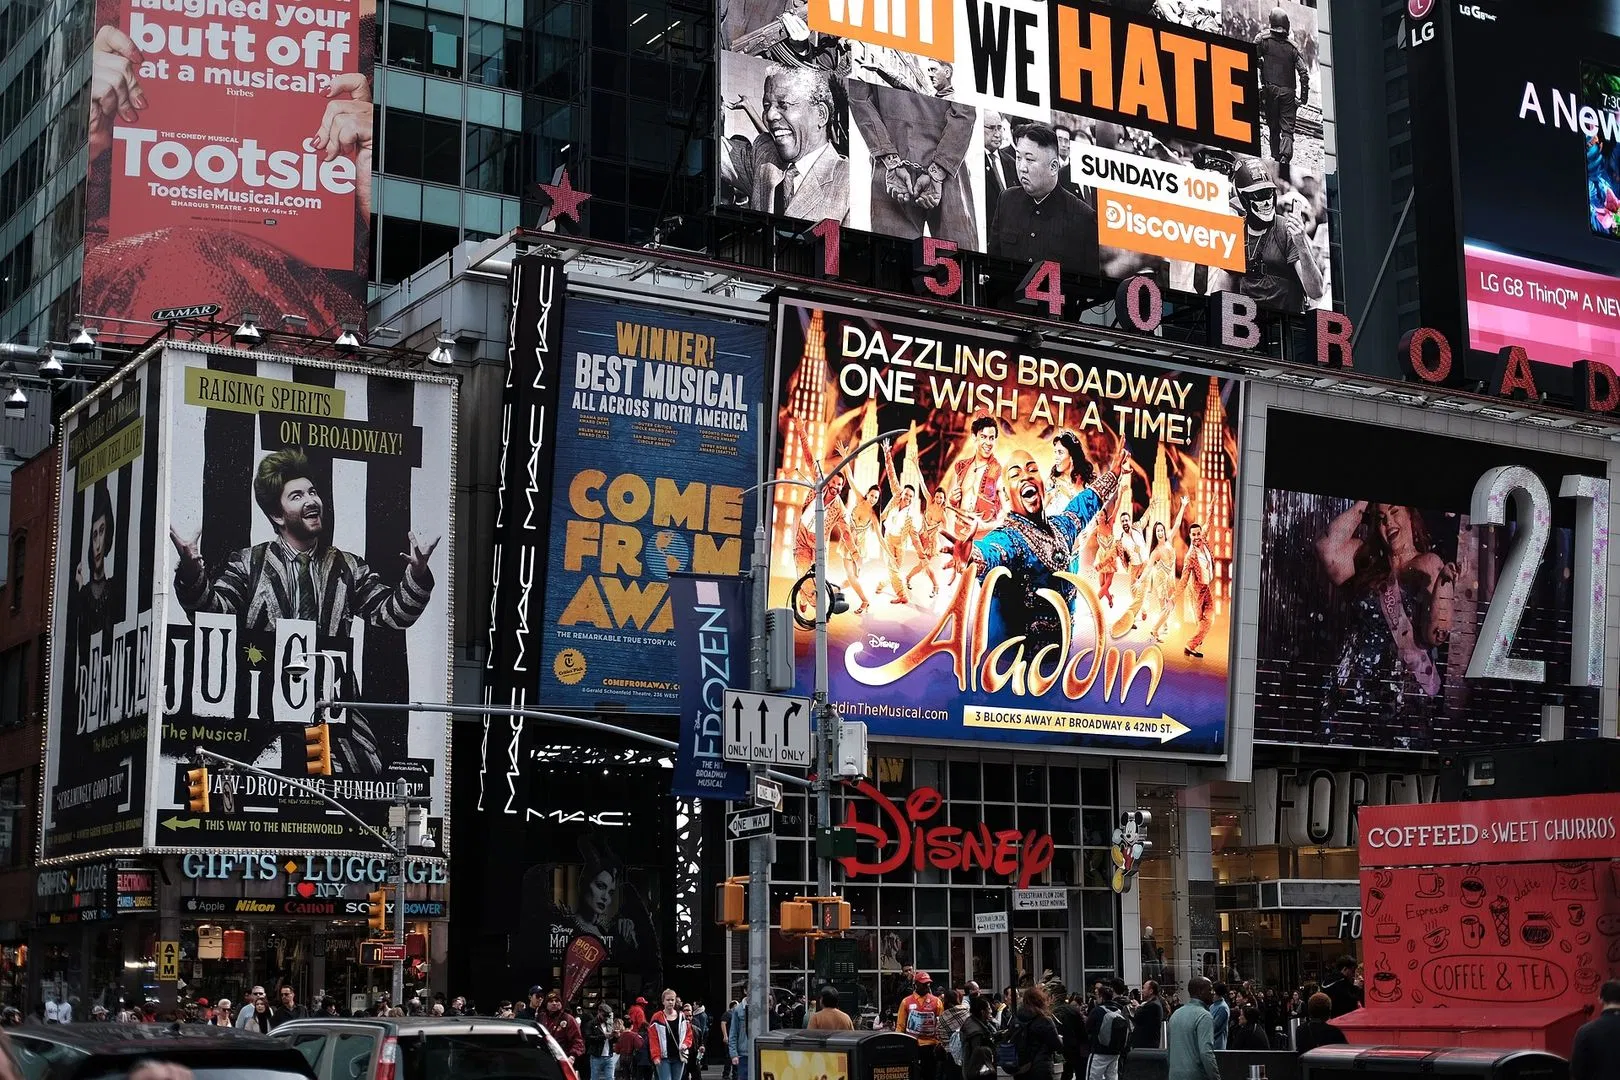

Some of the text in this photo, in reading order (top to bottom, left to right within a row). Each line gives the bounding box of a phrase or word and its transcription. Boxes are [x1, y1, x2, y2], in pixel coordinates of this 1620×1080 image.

[275, 4, 351, 28] your
[130, 12, 351, 71] butt off
[1411, 21, 1435, 47] LG
[138, 58, 169, 80] at
[177, 64, 195, 82] a
[966, 0, 1252, 143] WE HATE
[226, 87, 254, 97] Forbes
[1519, 82, 1620, 142] A New
[176, 133, 206, 141] COMEDY
[207, 135, 239, 143] MUSICAL
[113, 126, 356, 194] Tootsie
[1081, 154, 1219, 201] SUNDAYS 10P
[148, 183, 322, 209] TootsieMusical.com
[178, 201, 209, 210] MARQUIS
[211, 204, 242, 212] THEATRE
[1106, 199, 1236, 259] Discovery
[1480, 271, 1499, 292] LG
[1503, 277, 1523, 297] G8
[1583, 293, 1593, 312] A
[156, 305, 212, 320] LAMAR
[616, 321, 715, 368] WINNER!
[842, 325, 1193, 410] DAZZLING BROADWAY
[575, 352, 748, 412] BEST MUSICAL
[199, 376, 331, 417] RAISING SPIRITS
[839, 363, 1192, 446] ONE WISH AT A TIME!
[572, 391, 748, 431] ALL ACROSS NORTH AMERICA
[280, 420, 403, 455] ON BROADWAY!
[568, 469, 744, 535] COME
[1465, 464, 1611, 688] 21
[557, 575, 675, 633] AWA
[556, 631, 571, 639] THE
[573, 632, 621, 643] REMARKABLE
[623, 636, 641, 645] TRUE
[643, 637, 666, 647] STORY
[845, 562, 1165, 706] Aladdin
[603, 688, 631, 696] Schoenfeld
[161, 724, 187, 739] The
[192, 725, 250, 742] Musical.
[975, 711, 1173, 734] 3 BLOCKS AWAY AT BROADWAY & 42ND ST.
[728, 745, 747, 757] ONLY
[754, 746, 773, 759] ONLY
[781, 749, 804, 761] ONLY
[696, 769, 727, 778] BROADWAY
[702, 760, 723, 769] THE HIT
[333, 780, 425, 800] FUNHOUE!”
[697, 779, 723, 788] MUSICAL
[759, 786, 779, 800] ONE WAY
[205, 819, 224, 831] THIS
[228, 820, 247, 832] WAY
[250, 821, 261, 832] TO
[263, 822, 279, 833] THE
[281, 823, 343, 835] NETHERWORLD
[732, 819, 747, 831] ONE
[752, 815, 767, 827] WAY
[1368, 816, 1616, 848] COFFEED & SWEET CHURROS
[183, 855, 447, 884] GIFTS LUGGGE
[288, 882, 347, 898] I NY
[1514, 878, 1541, 901] Latte
[81, 909, 98, 921] SONY
[199, 901, 224, 913] Apple
[235, 900, 275, 912] Nikon
[284, 902, 334, 913] Canon
[345, 902, 394, 913] SOY
[404, 903, 441, 914] BOWER
[1405, 903, 1450, 921] Espresso
[267, 938, 286, 948] 550
[575, 938, 590, 950] BIG
[164, 944, 175, 974] ATM
[1433, 962, 1556, 991] COFFEE & TEA
